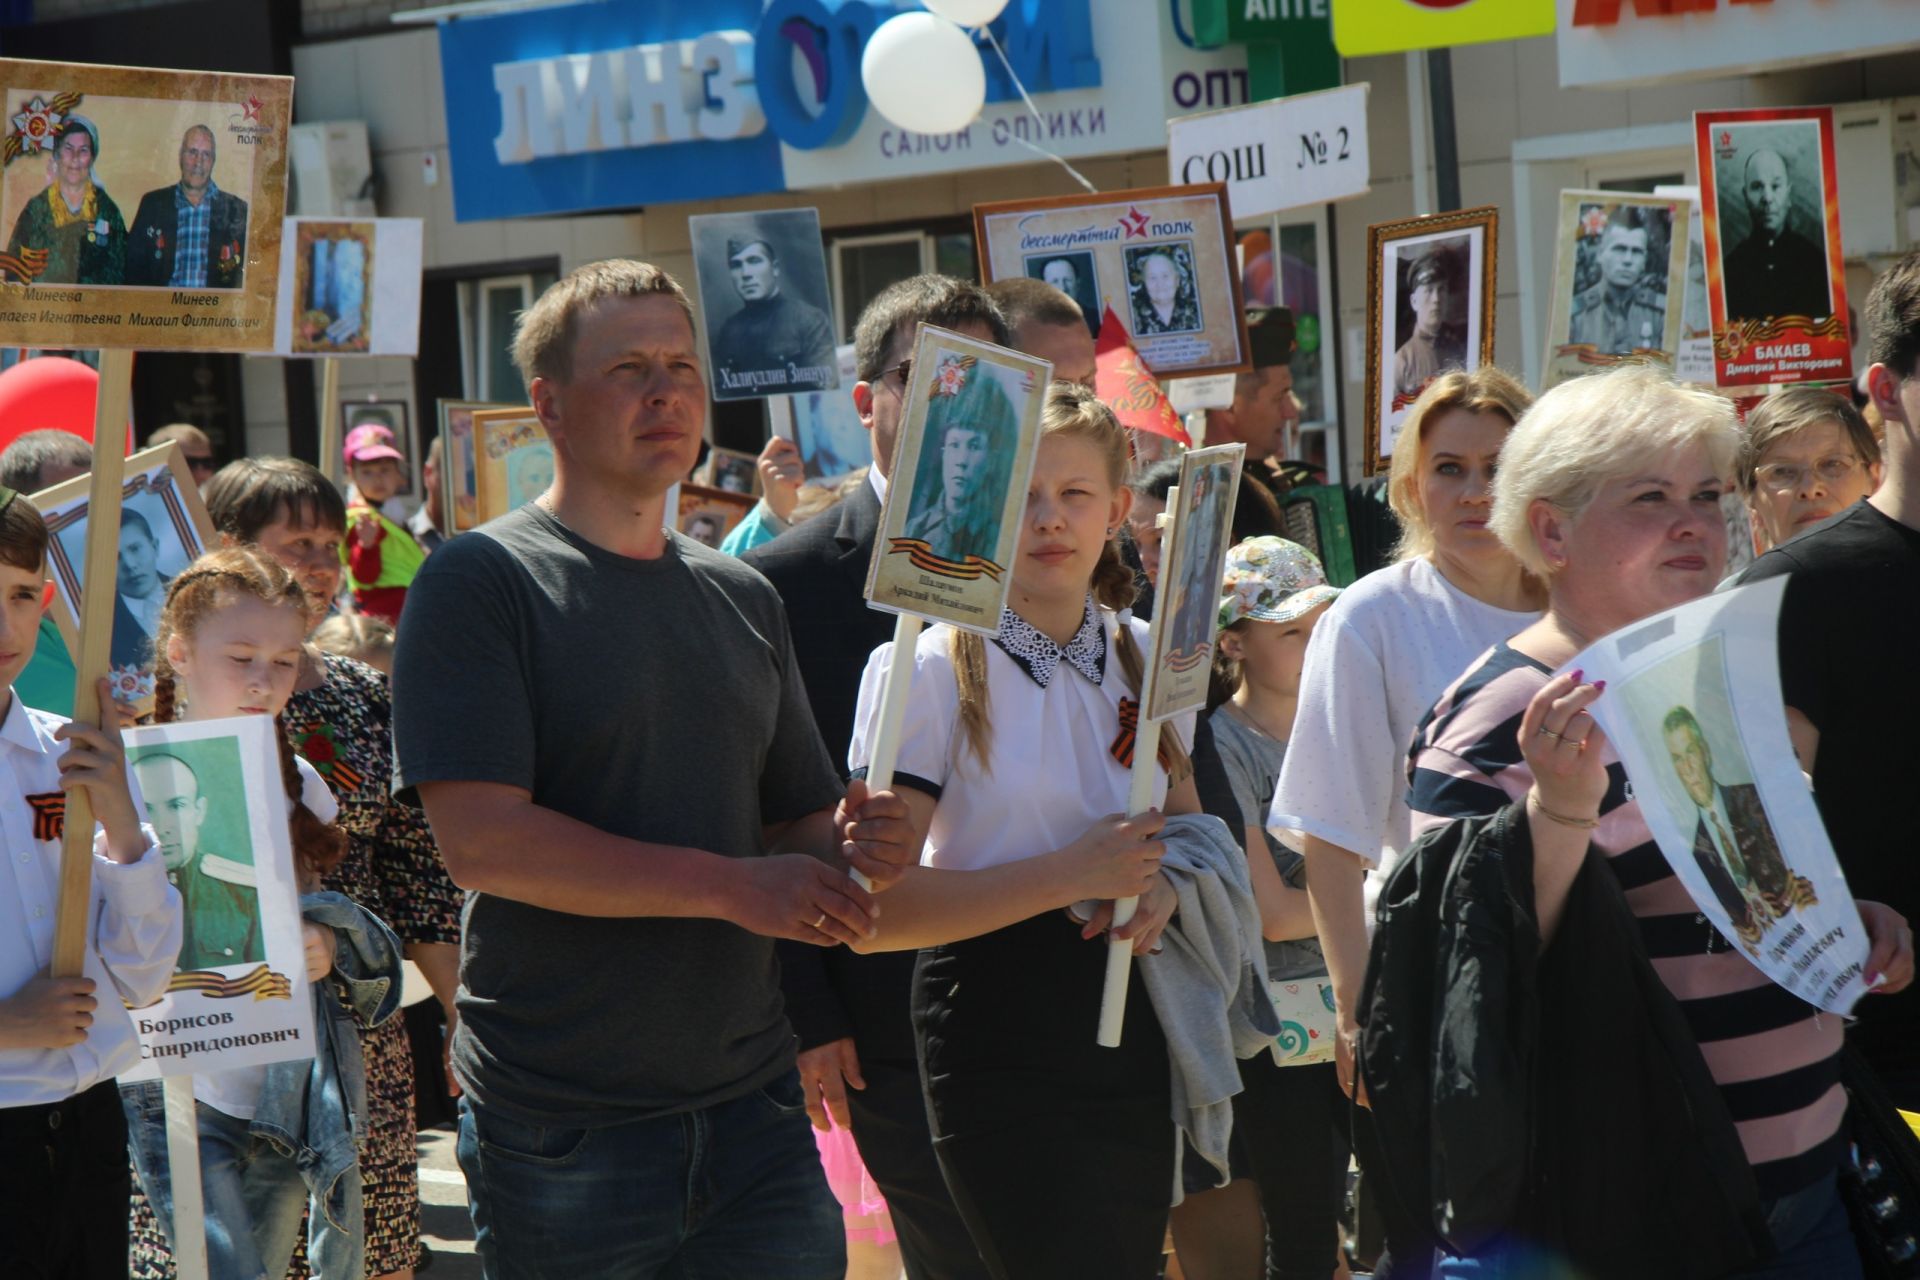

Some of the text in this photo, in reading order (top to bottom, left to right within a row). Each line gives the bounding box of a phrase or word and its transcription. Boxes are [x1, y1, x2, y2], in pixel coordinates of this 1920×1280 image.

[493, 0, 1101, 166] ЛИНЗОИ
[880, 107, 1107, 159] САЛОН ОПТИКИ
[1182, 126, 1350, 184] СОШ № 2
[23, 286, 83, 303] Минеева
[171, 291, 220, 306] Минеев
[39, 310, 122, 326] Игнатьевна
[129, 312, 179, 327] Михаил
[1755, 343, 1812, 360] БАКАЕВ
[1725, 359, 1776, 376] Дмитрий
[1778, 357, 1843, 372] Викторович
[138, 1011, 235, 1036] Борисов
